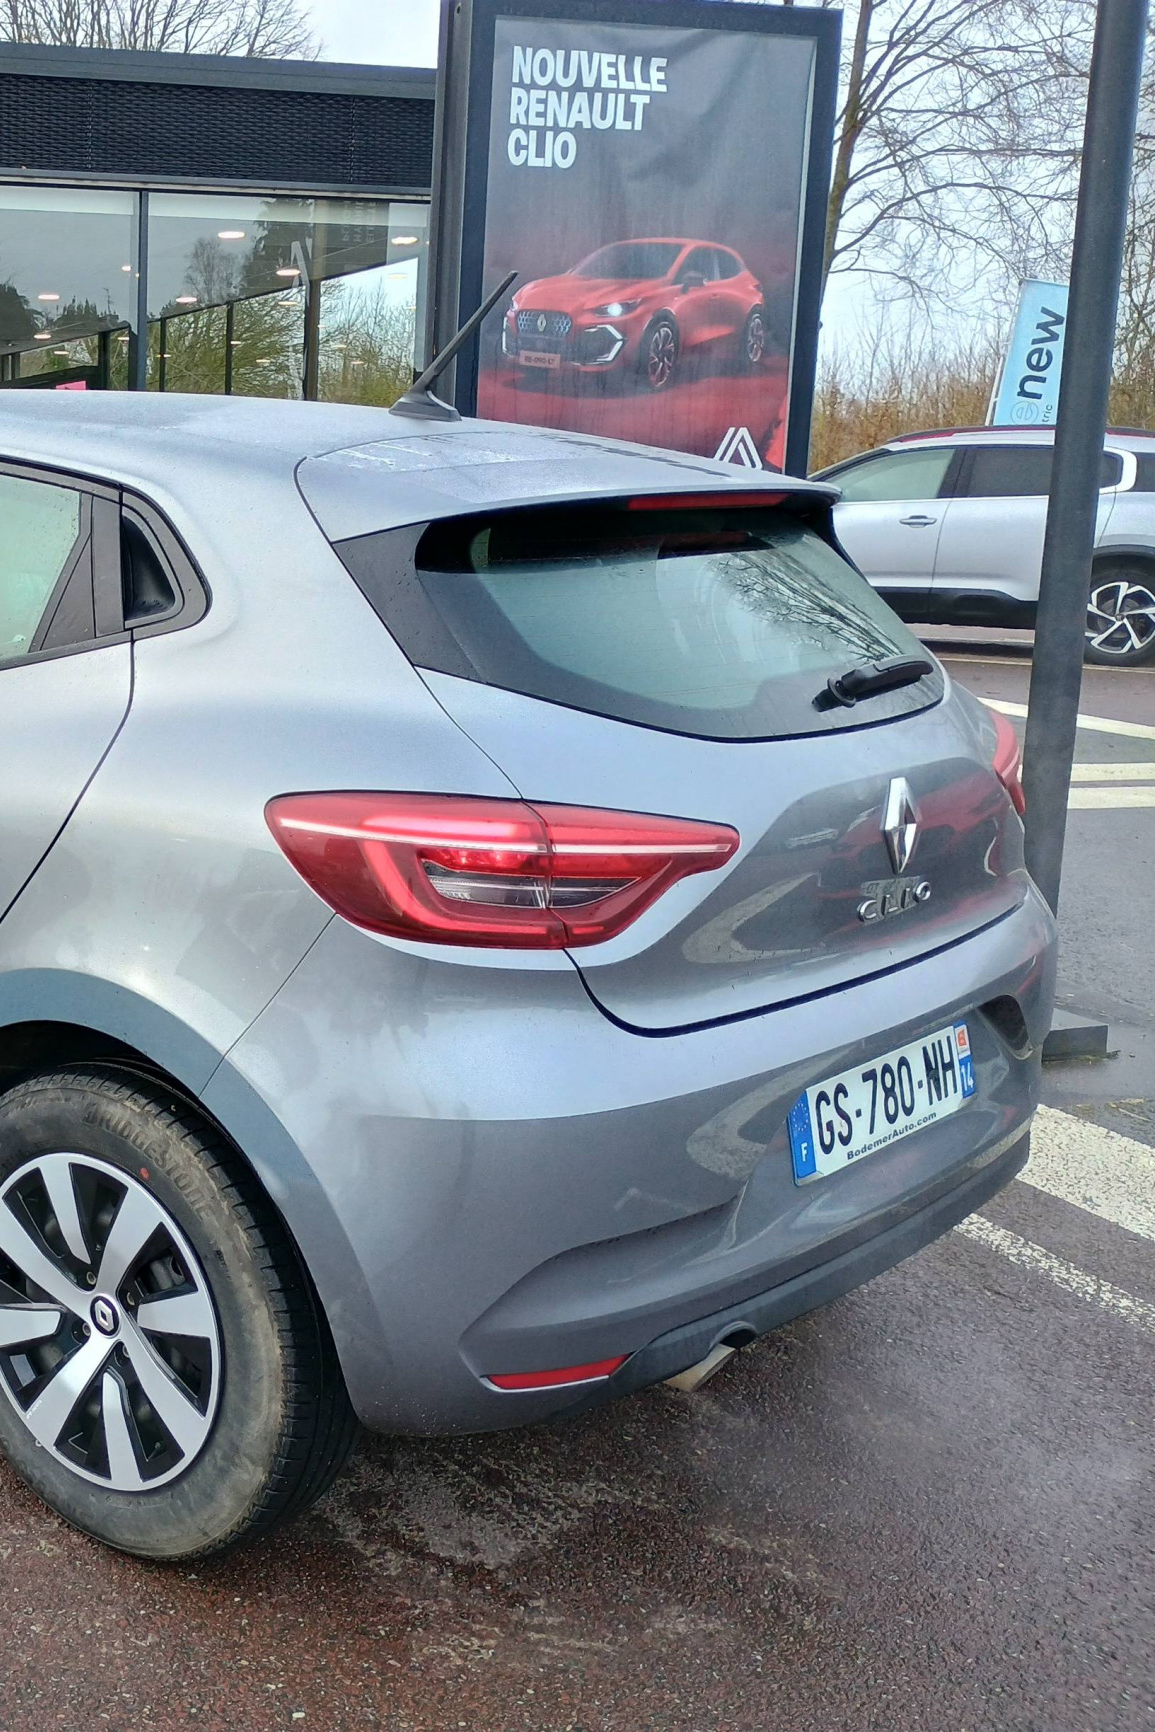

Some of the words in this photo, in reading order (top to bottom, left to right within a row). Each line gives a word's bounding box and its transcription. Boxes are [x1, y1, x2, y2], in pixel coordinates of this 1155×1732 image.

[512, 45, 668, 92] NOUVELLE
[510, 87, 651, 131] RENAULT
[507, 128, 577, 169] CLIO
[1017, 306, 1065, 400] new
[857, 881, 931, 920] CLIO
[816, 1035, 958, 1155] GS-780-NH
[961, 1062, 974, 1092] 14
[801, 1142, 808, 1162] F
[846, 1111, 937, 1160] BodemerAuto.com
